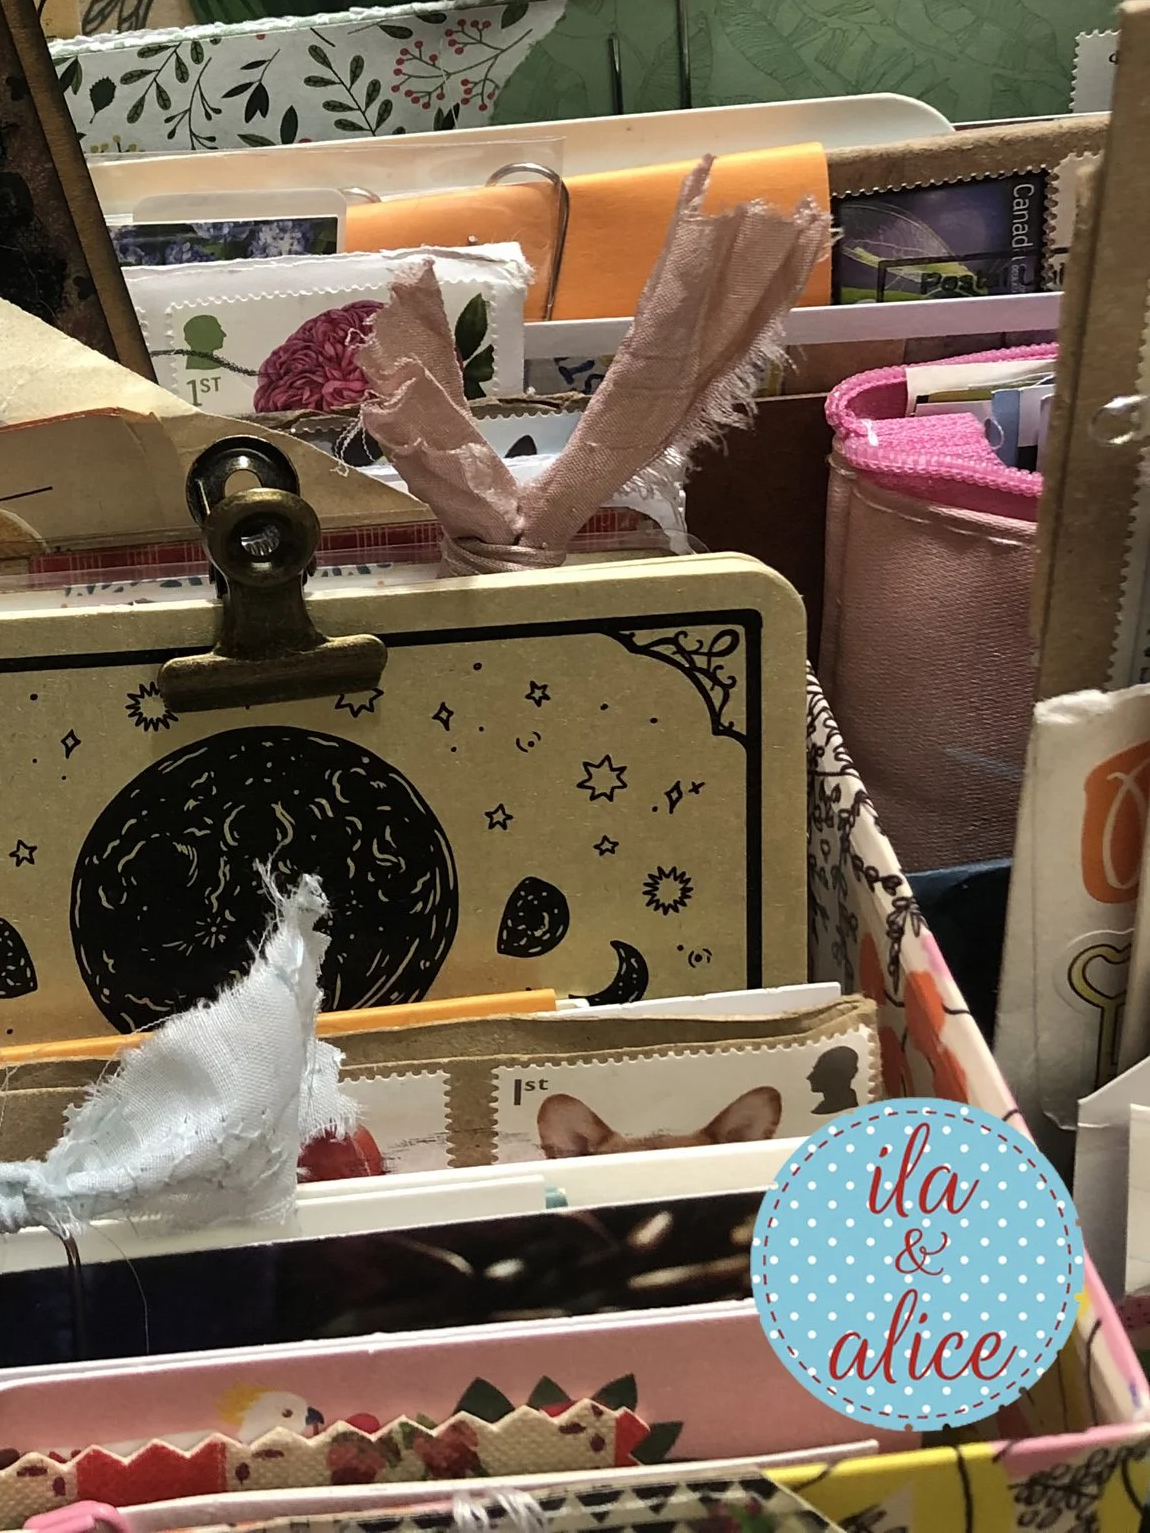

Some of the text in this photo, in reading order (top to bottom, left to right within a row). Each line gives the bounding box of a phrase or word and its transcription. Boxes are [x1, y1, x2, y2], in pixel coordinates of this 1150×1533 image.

[1012, 183, 1035, 262] Canad
[186, 376, 221, 407] 1ST
[514, 1078, 549, 1106] 1st
